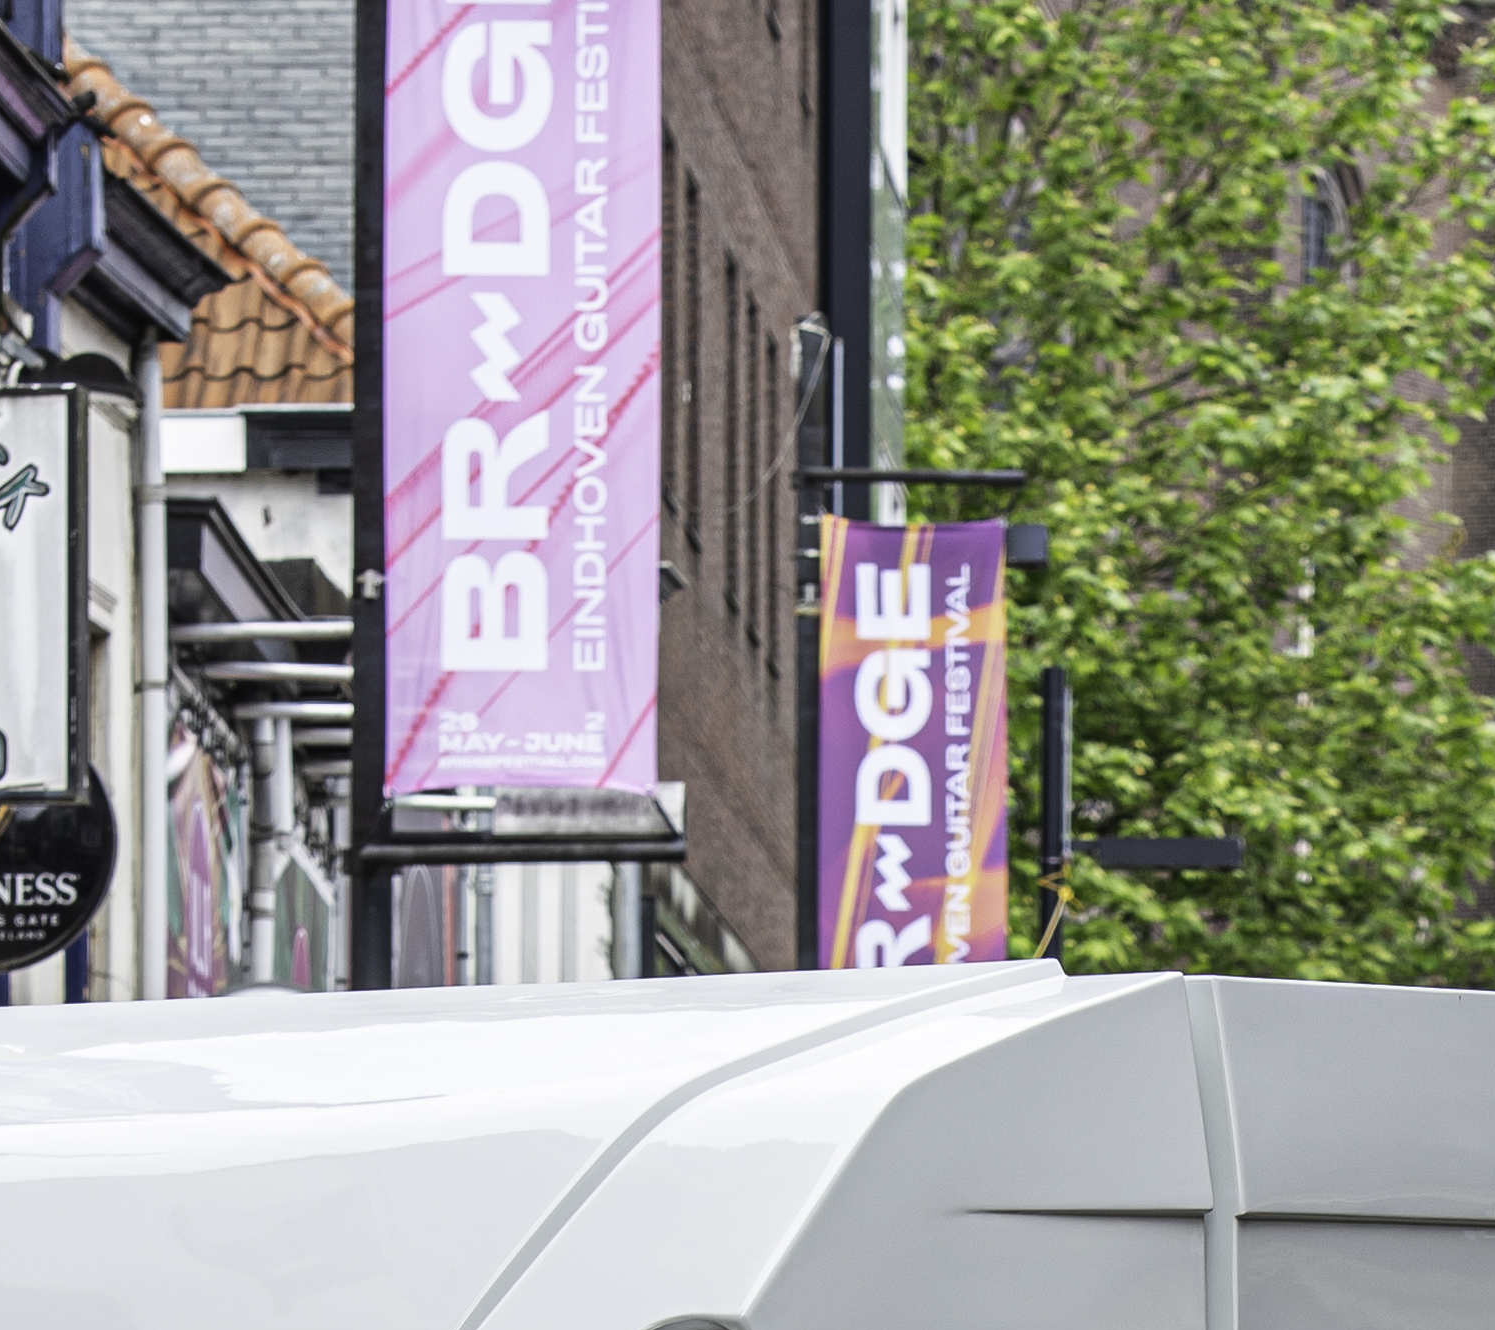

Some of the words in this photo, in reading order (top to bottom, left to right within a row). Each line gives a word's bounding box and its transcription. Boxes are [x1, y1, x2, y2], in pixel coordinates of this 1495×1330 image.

[574, 159, 609, 352] GUITAR
[572, 366, 608, 671] EINDHOVEN
[584, 711, 606, 732] 2
[944, 563, 973, 736] FESTIVAL
[439, 732, 504, 753] MAY
[523, 732, 604, 754] JUNE
[944, 742, 973, 878] GUITAR
